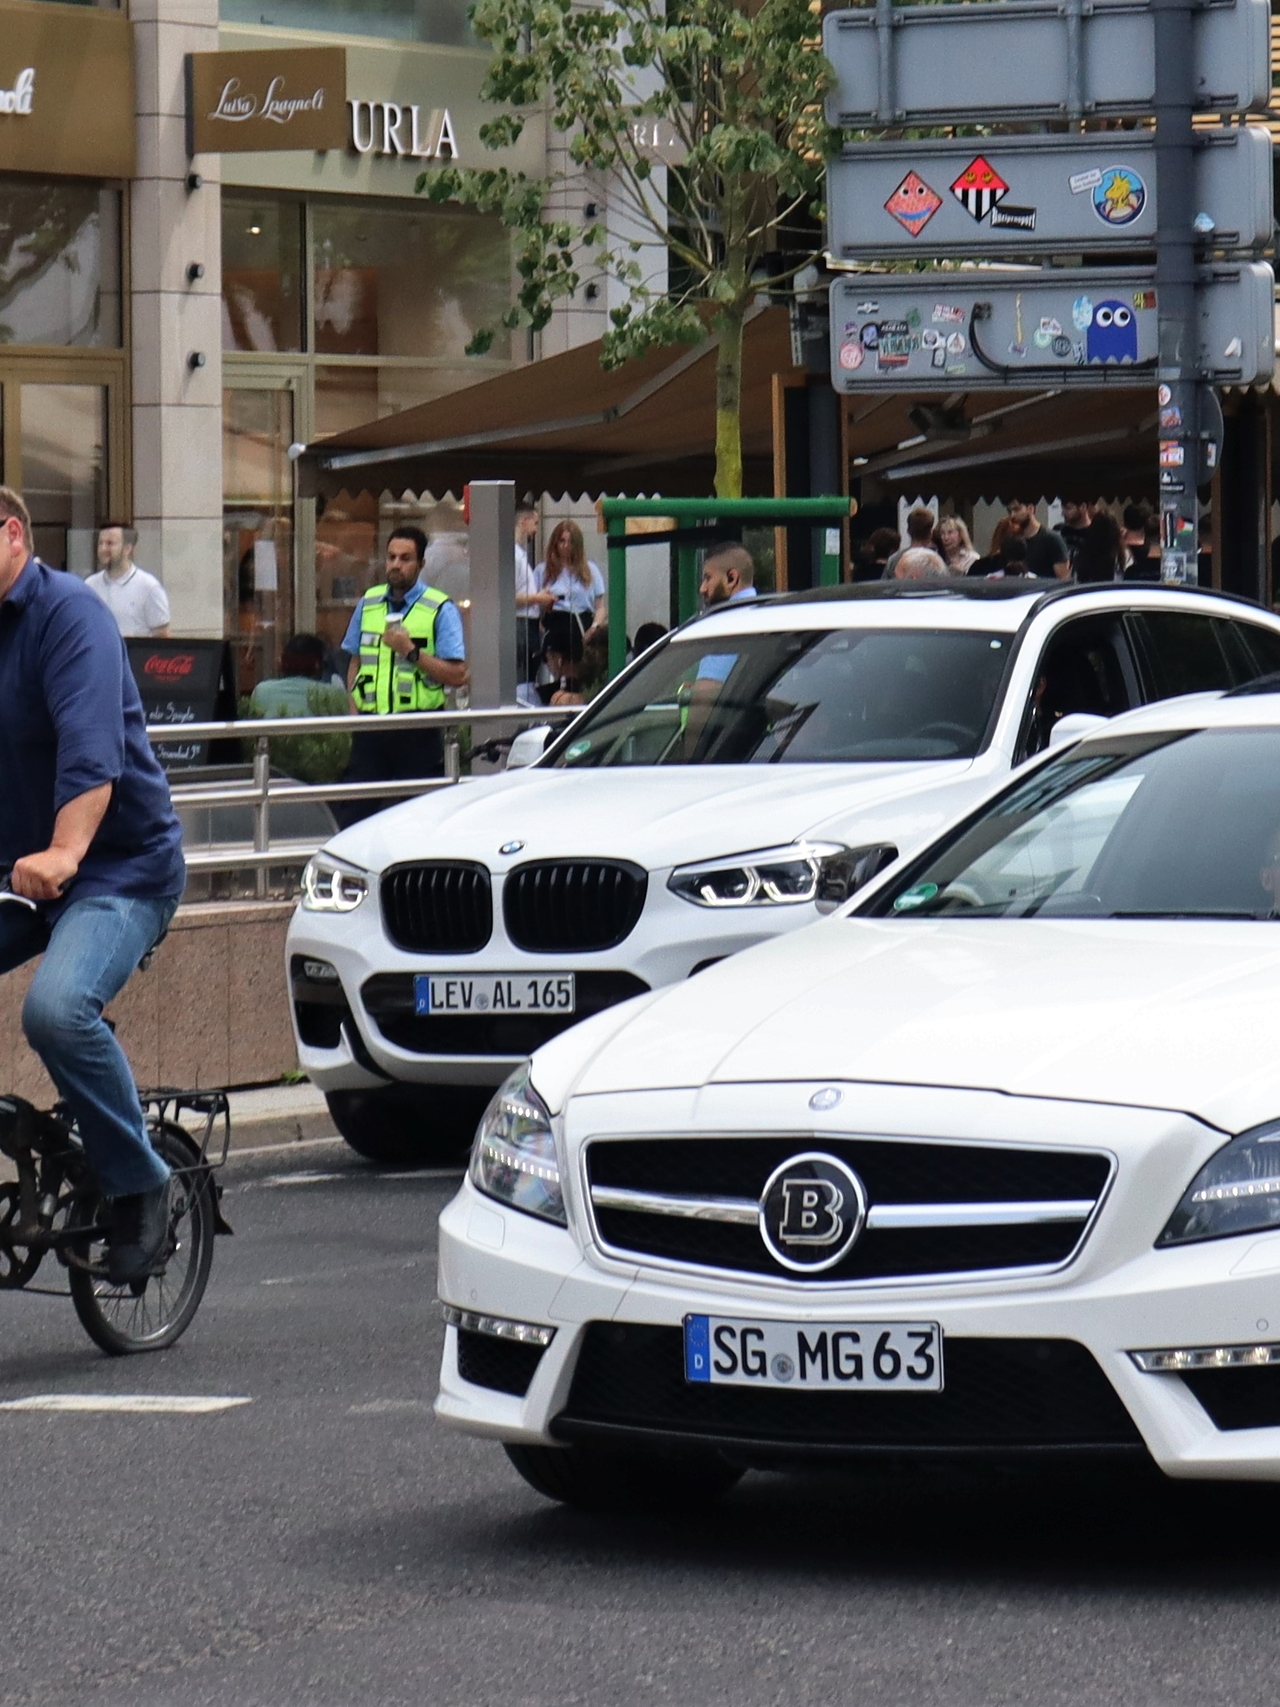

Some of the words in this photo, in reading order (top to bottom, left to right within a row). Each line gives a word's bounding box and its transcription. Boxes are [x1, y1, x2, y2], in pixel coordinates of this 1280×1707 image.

[207, 77, 257, 122] Luisa
[258, 75, 325, 124] Spagnoli
[352, 99, 459, 159] URLA
[431, 981, 473, 1009] LEV
[492, 980, 521, 1008] AL
[527, 979, 571, 1009] 165
[779, 1179, 844, 1245] B
[694, 1354, 704, 1369] D
[713, 1325, 767, 1377] SG
